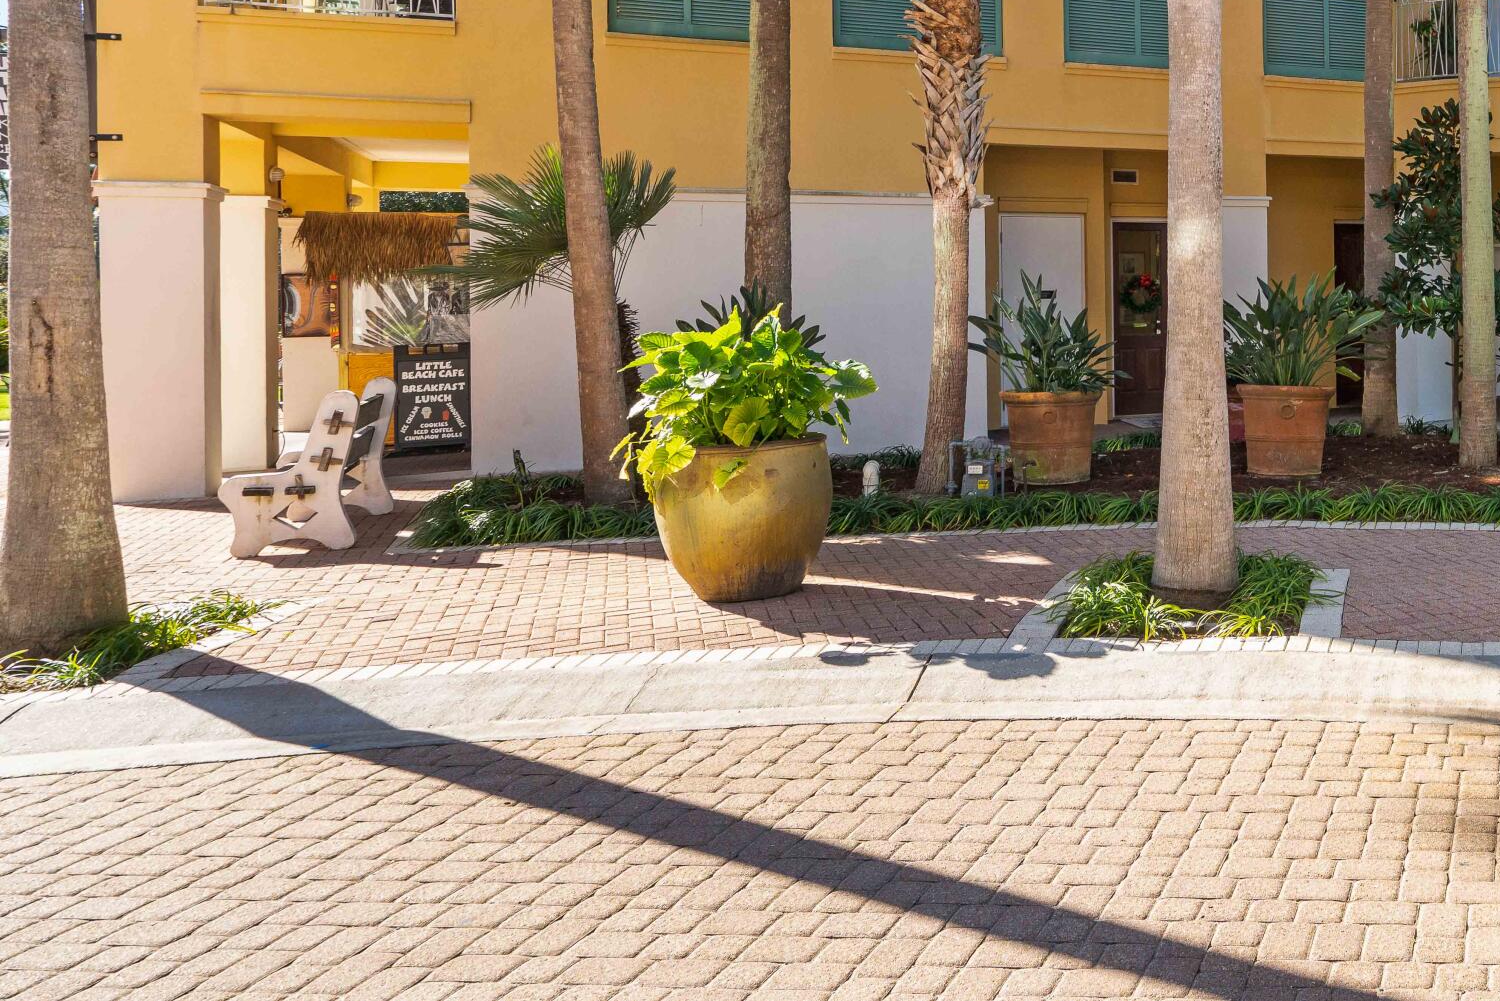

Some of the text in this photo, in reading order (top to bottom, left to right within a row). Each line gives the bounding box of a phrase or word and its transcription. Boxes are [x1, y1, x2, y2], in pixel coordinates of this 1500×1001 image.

[415, 361, 452, 370] LITTLE
[401, 369, 464, 379] BEACH CAFE
[402, 382, 465, 393] BREAKFAST
[415, 394, 452, 404] LUNCH
[406, 405, 420, 425] CREAM
